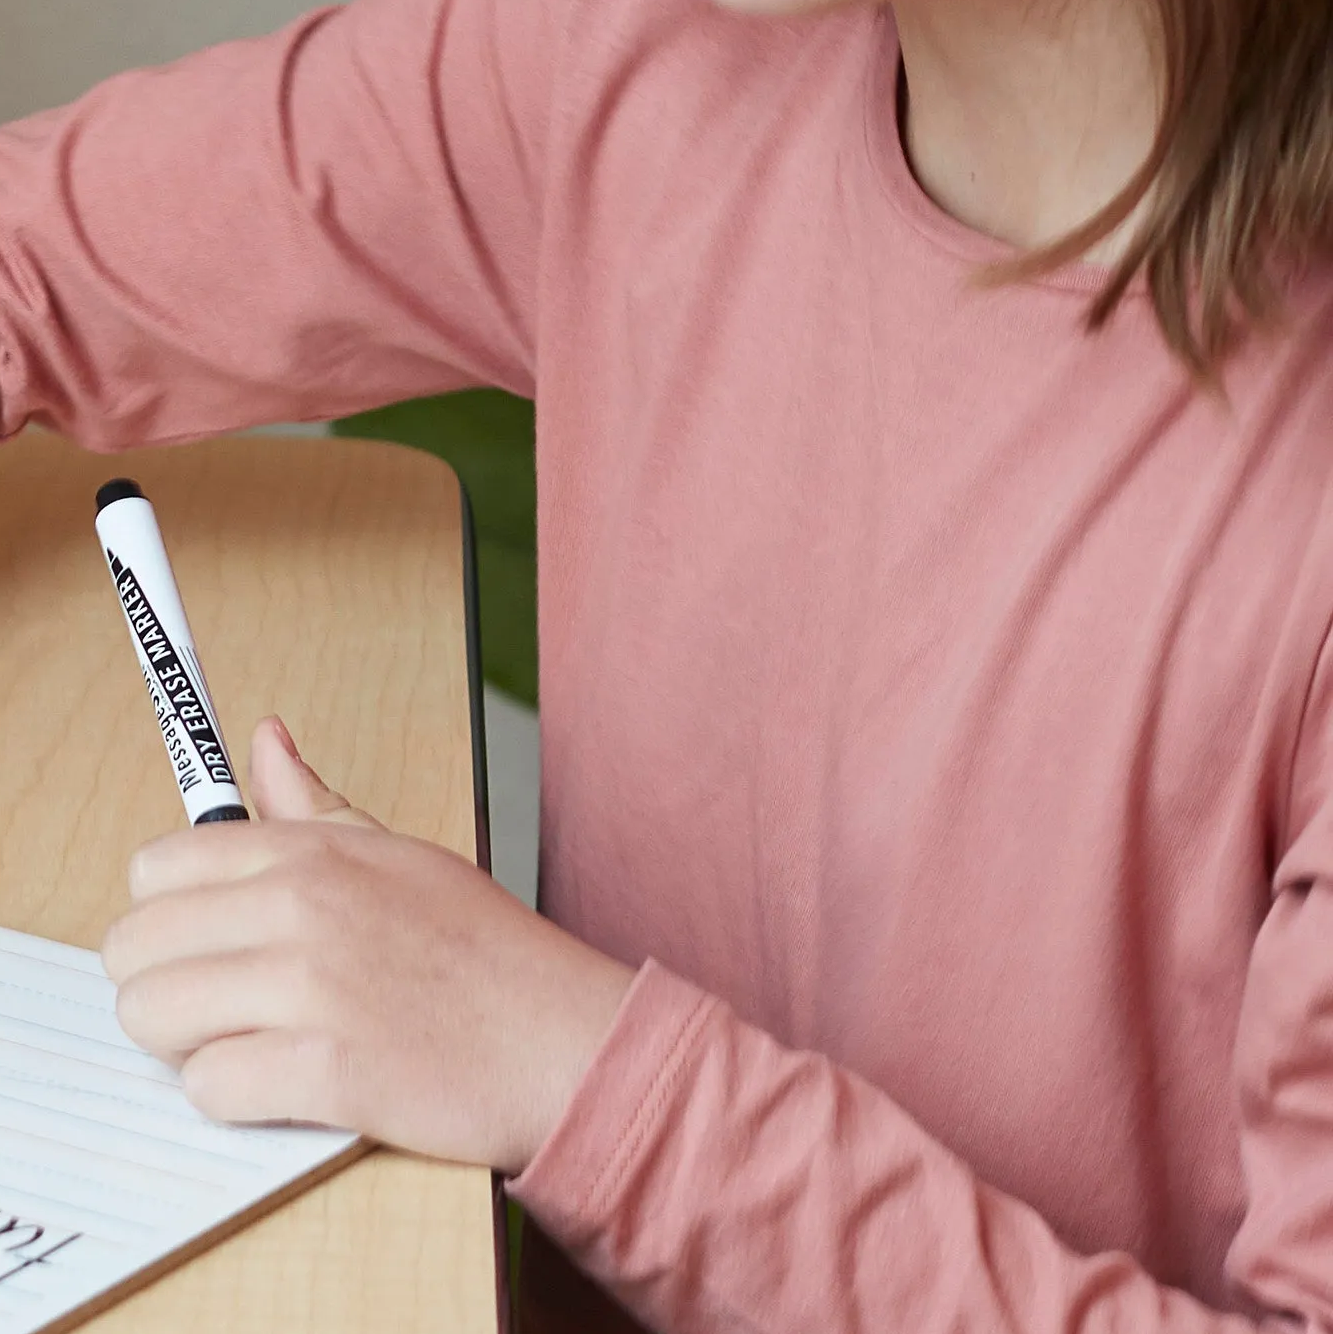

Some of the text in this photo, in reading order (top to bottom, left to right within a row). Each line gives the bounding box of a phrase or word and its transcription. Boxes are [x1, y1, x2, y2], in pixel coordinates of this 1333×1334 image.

[118, 574, 173, 664] MARKER
[157, 662, 209, 732] ERASE
[194, 737, 233, 784] DRY
